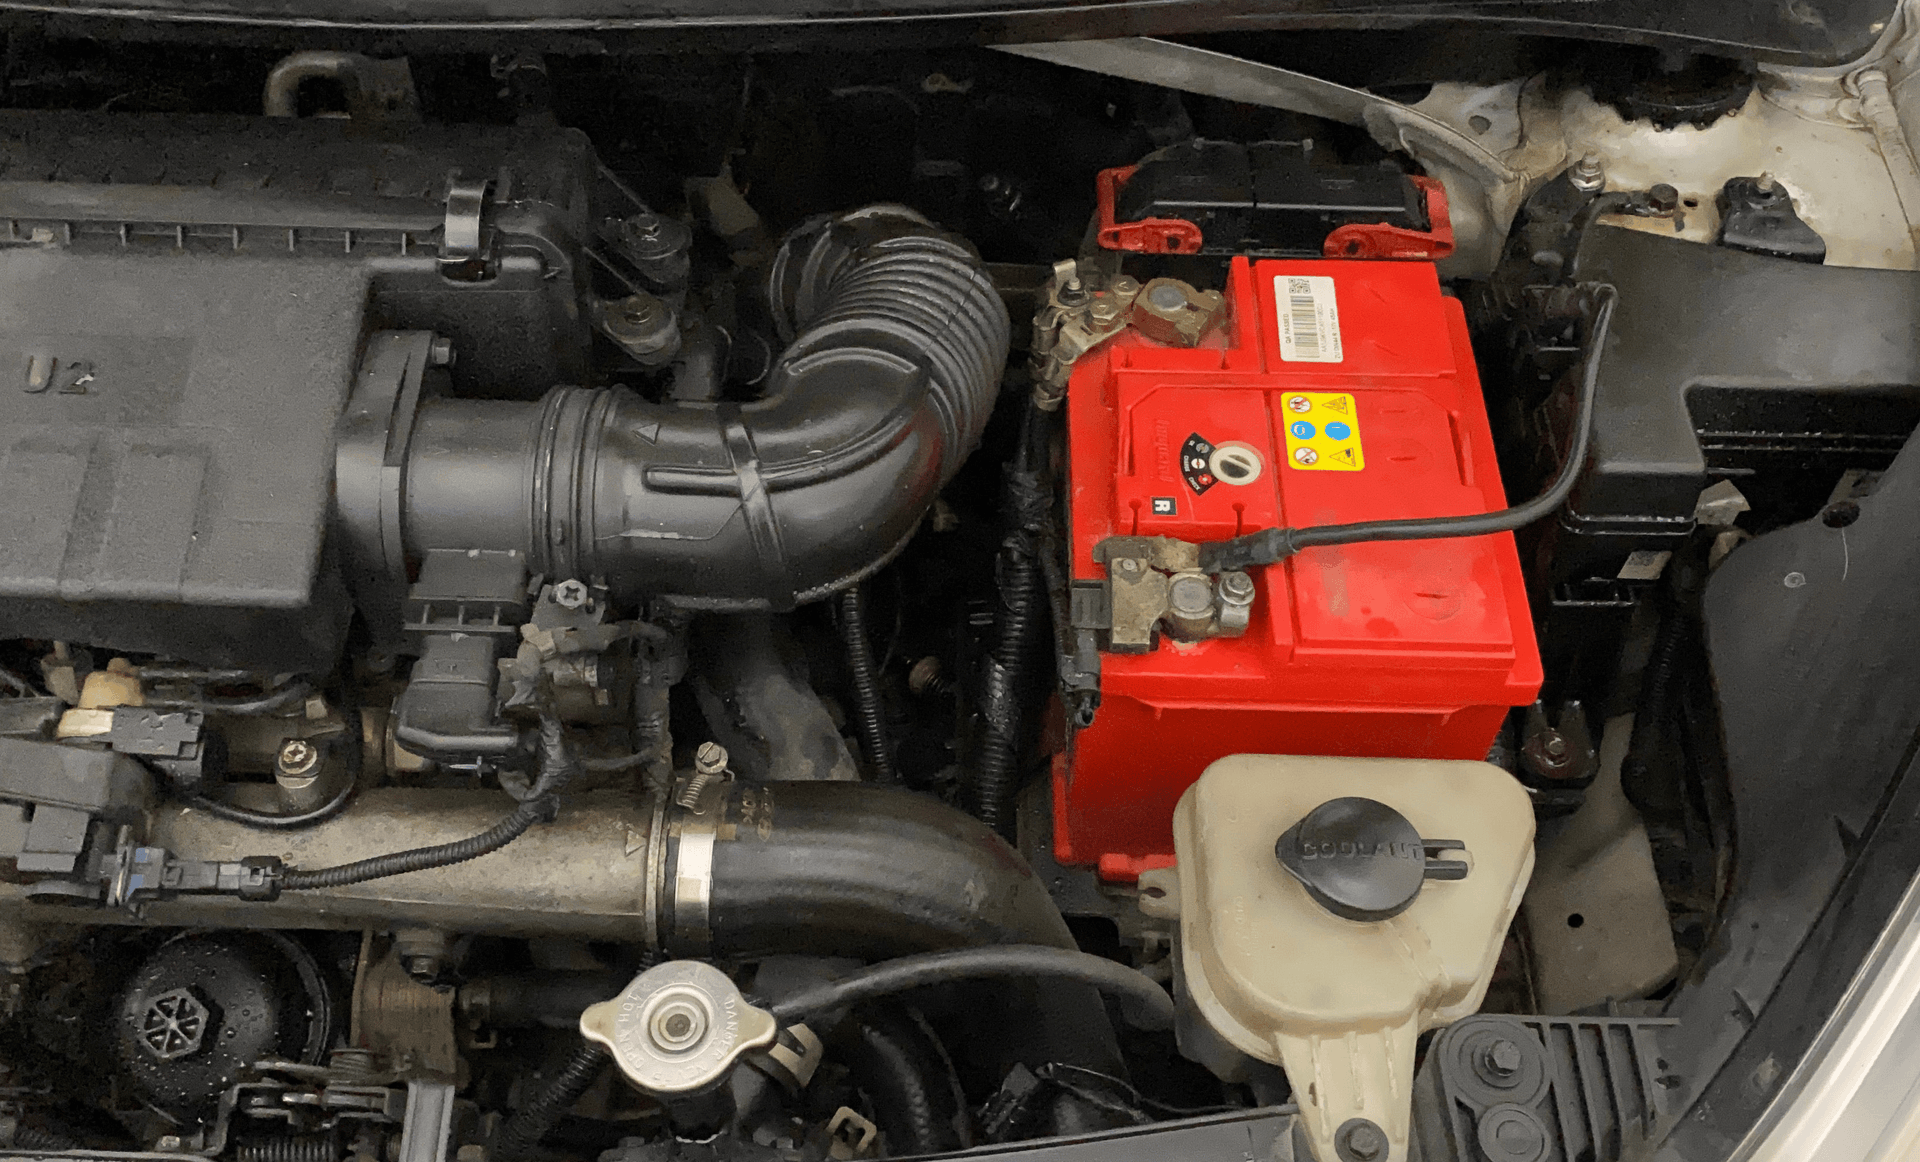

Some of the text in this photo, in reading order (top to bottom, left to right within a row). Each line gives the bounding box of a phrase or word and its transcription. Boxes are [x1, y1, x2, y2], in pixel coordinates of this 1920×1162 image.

[1283, 313, 1291, 335] PASSED
[1154, 500, 1171, 512] R
[1302, 842, 1421, 860] COOLANT
[618, 992, 643, 1023] HOT
[714, 994, 739, 1062] DANGER
[652, 1063, 709, 1082] NEVR
